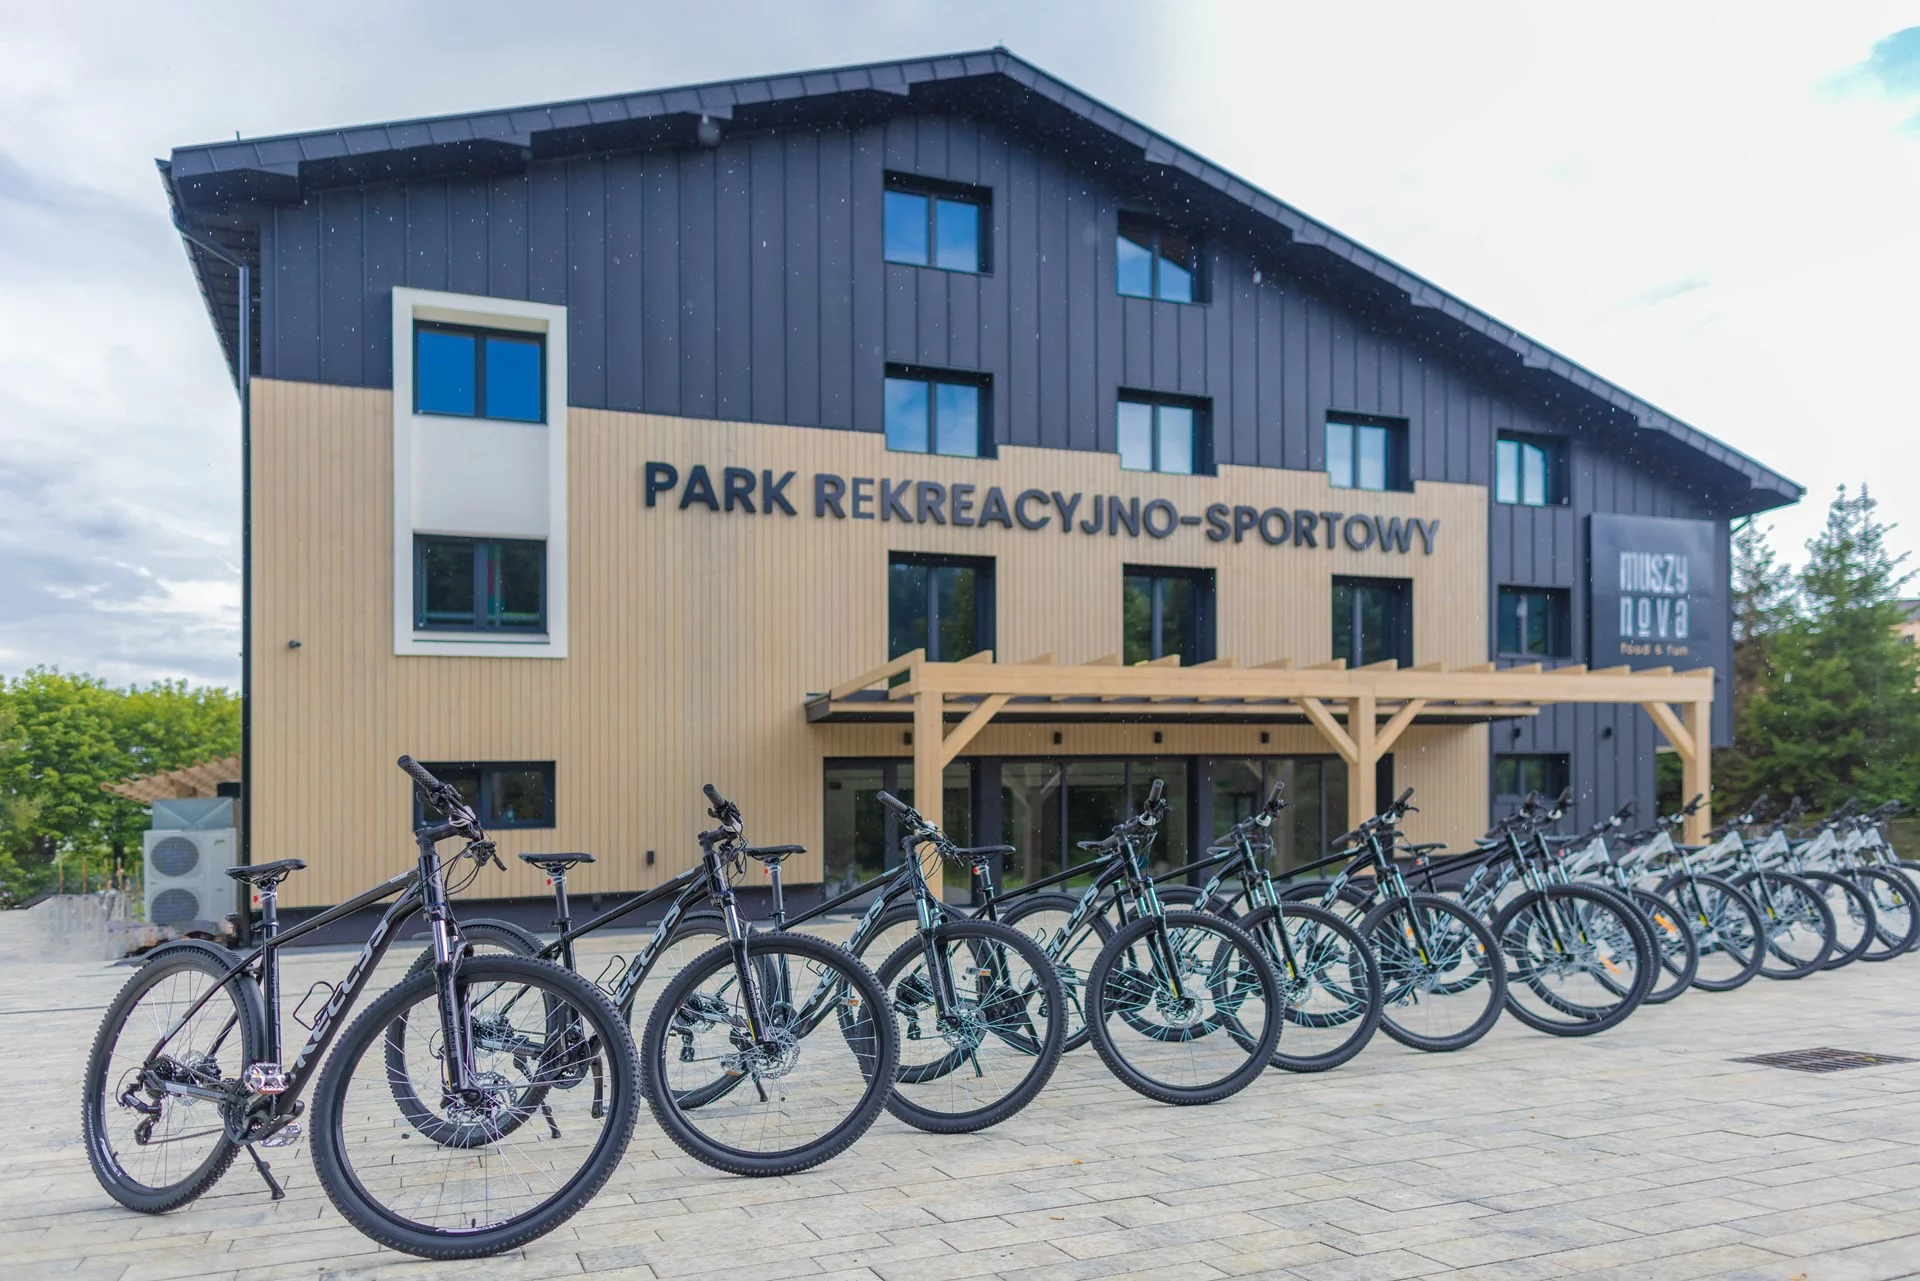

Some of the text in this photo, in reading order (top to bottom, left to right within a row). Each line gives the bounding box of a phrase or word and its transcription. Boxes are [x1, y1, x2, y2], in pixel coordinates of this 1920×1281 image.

[645, 461, 1441, 555] PARK REKREACYJNO-SPORTOWY
[613, 903, 681, 1006] ELLYS
